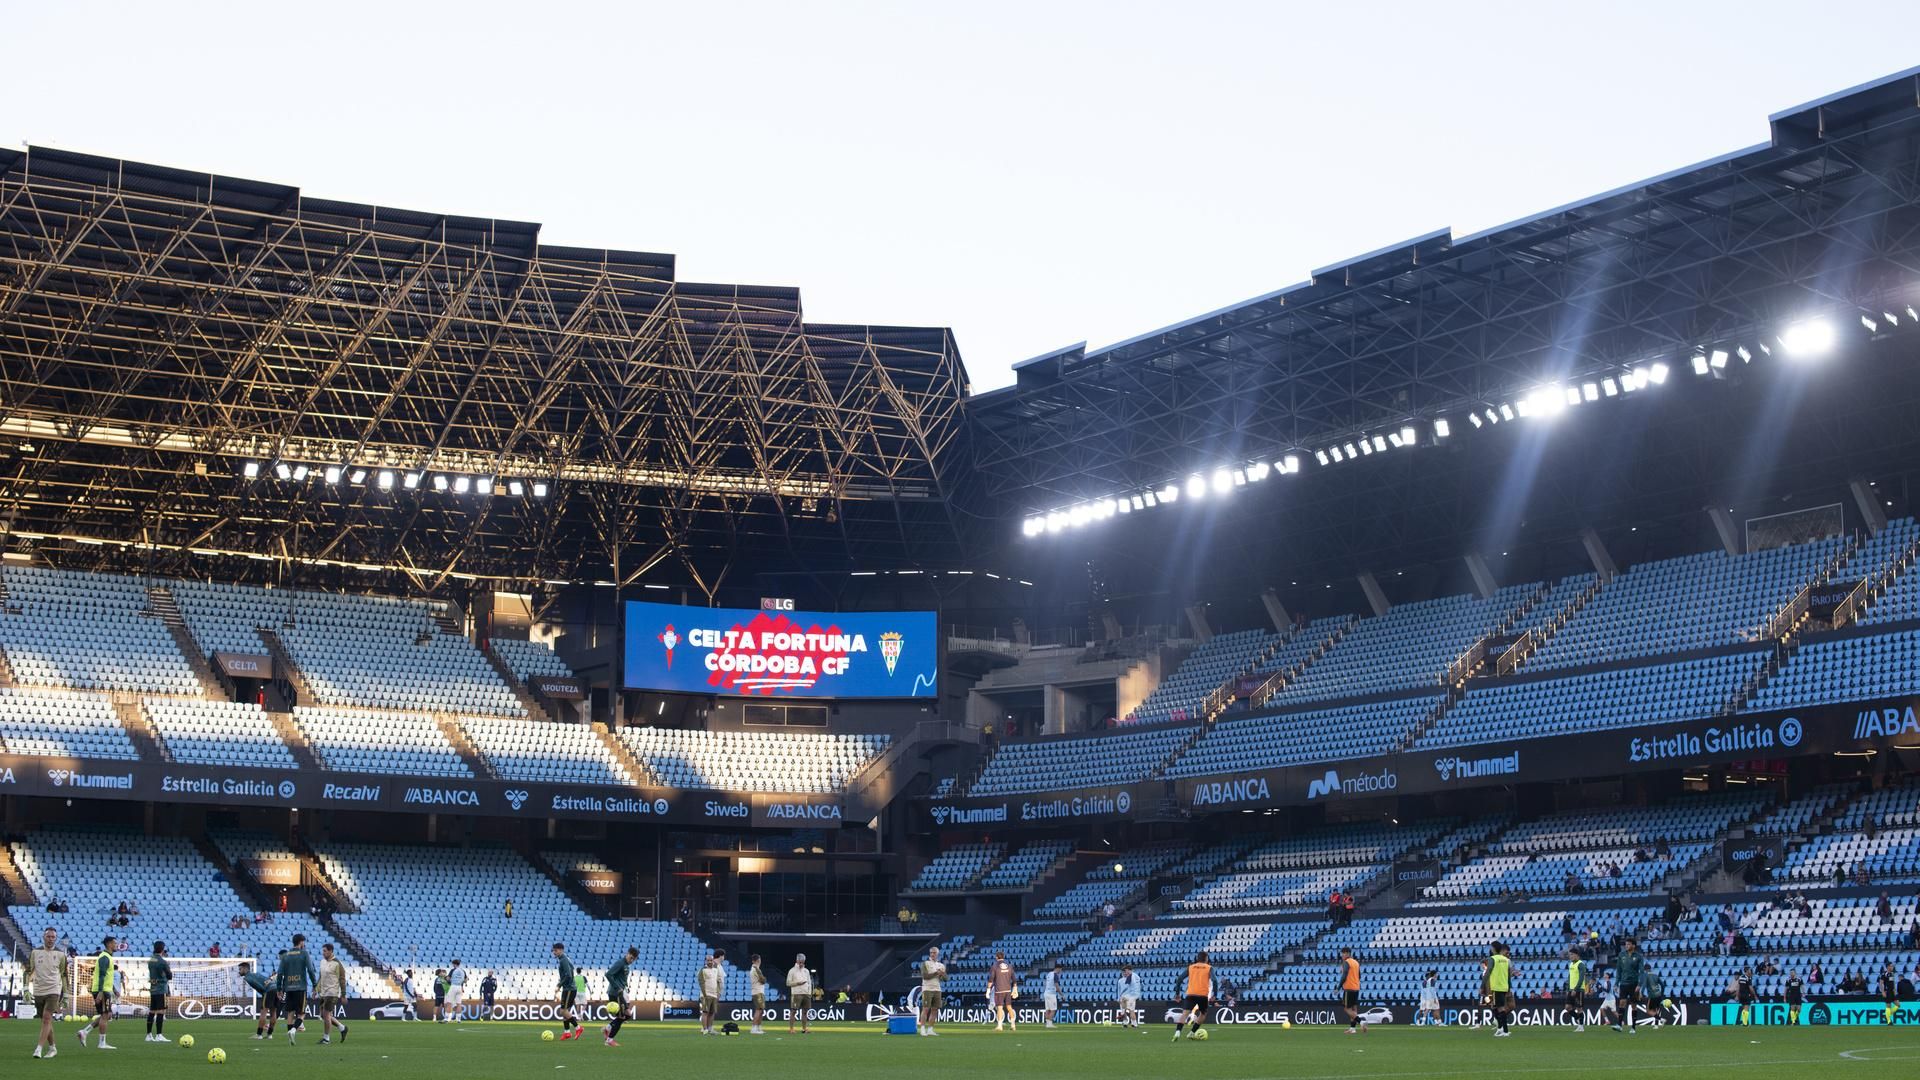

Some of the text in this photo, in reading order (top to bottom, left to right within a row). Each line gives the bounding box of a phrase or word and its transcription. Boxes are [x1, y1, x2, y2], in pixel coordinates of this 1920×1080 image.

[775, 598, 793, 610] LG
[689, 629, 867, 652] CELTA FORTUNA
[228, 660, 258, 671] CELTA
[704, 648, 850, 674] CÓRDOBA CF
[540, 684, 579, 693] AFOUTEZA
[1630, 727, 1774, 762] Estrella Galicia
[1456, 751, 1519, 776] hummel
[70, 773, 133, 790] hummel
[161, 776, 275, 797] Estrella Galicia
[1342, 768, 1397, 792] método
[323, 783, 380, 801] Recalvi
[552, 795, 651, 815] Estrella Galicia
[705, 801, 749, 818] Siweb
[950, 804, 1007, 823] hummel
[1021, 797, 1115, 820] Estrella Galicia
[1732, 849, 1774, 860] ORGUO
[1295, 1010, 1337, 1025] GALICIA
